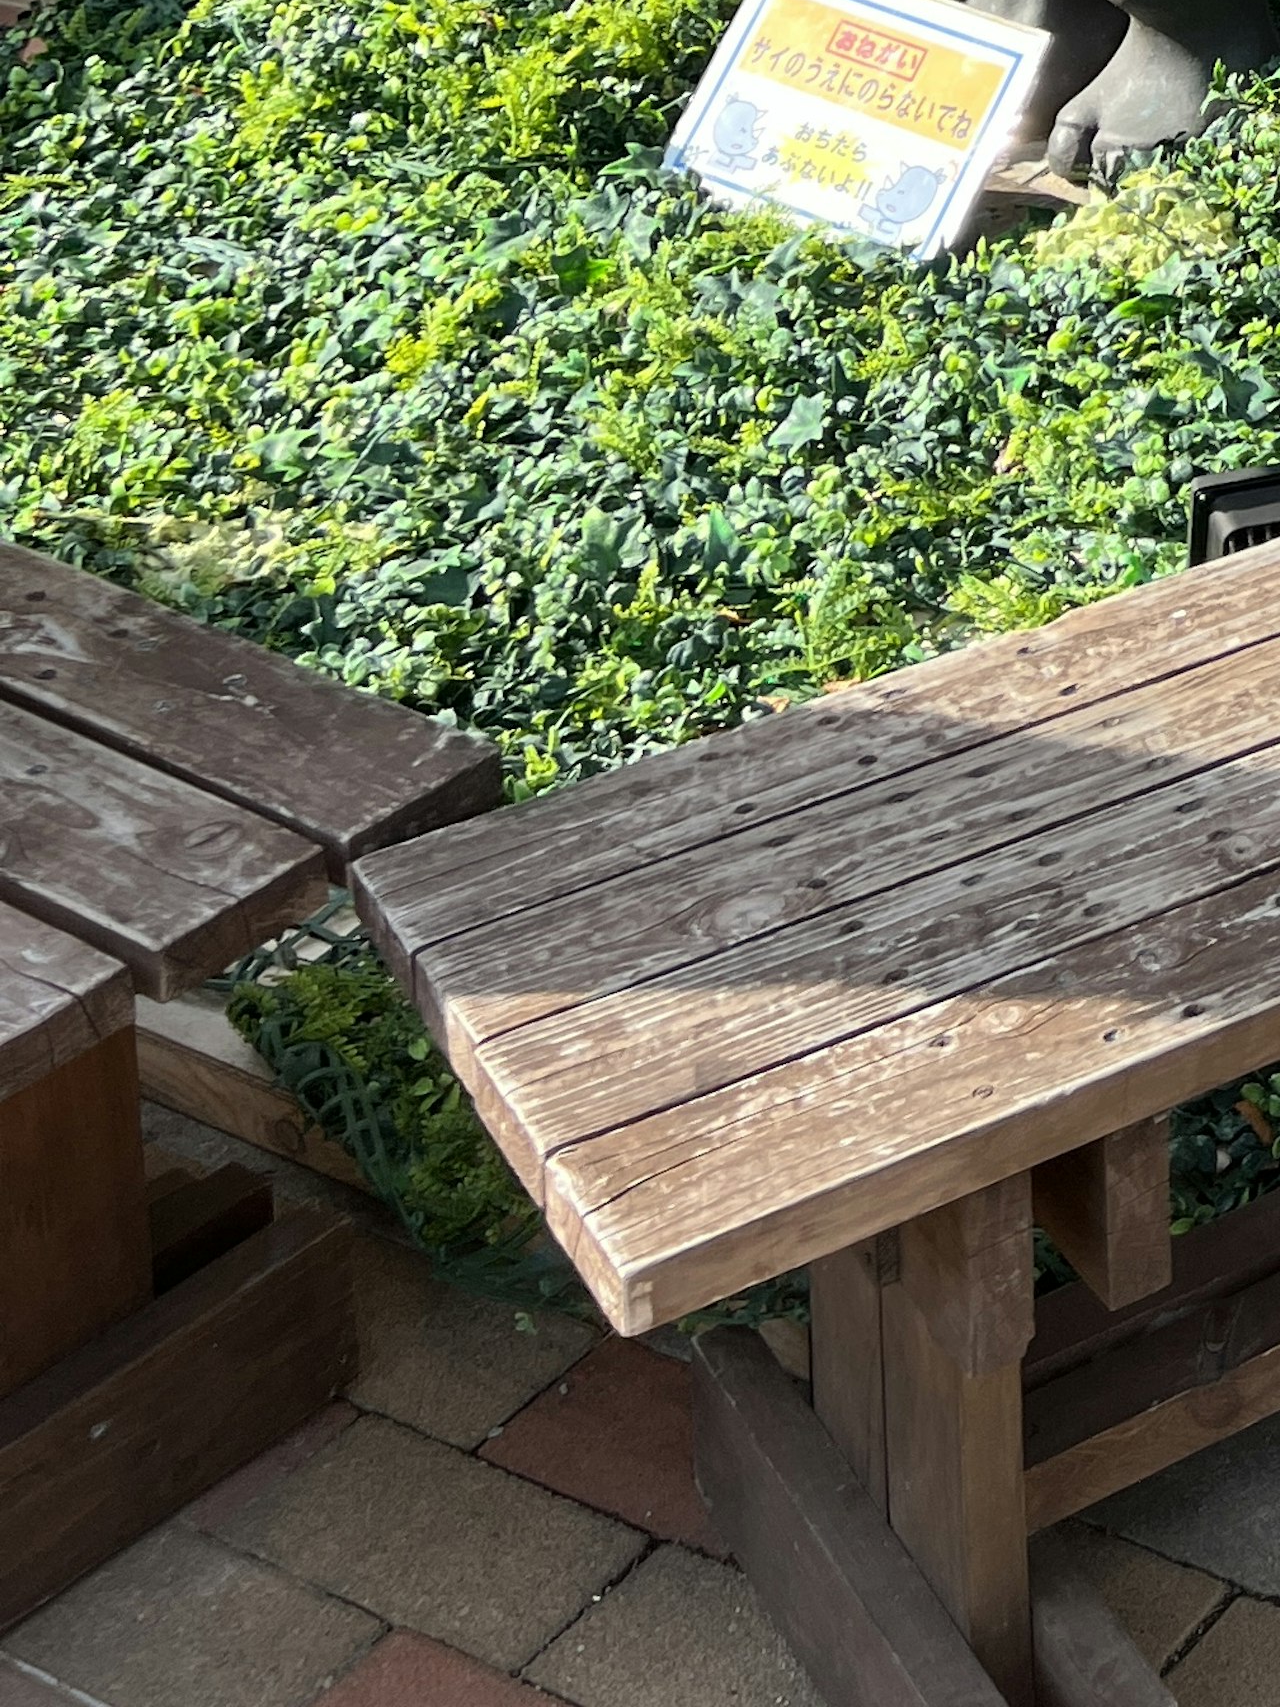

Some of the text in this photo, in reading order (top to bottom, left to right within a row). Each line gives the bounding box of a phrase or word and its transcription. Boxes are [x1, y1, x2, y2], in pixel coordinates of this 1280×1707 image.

[835, 30, 918, 70] おねがい
[752, 36, 972, 139] サイのうえにのらないでね
[794, 122, 868, 163] おちたら
